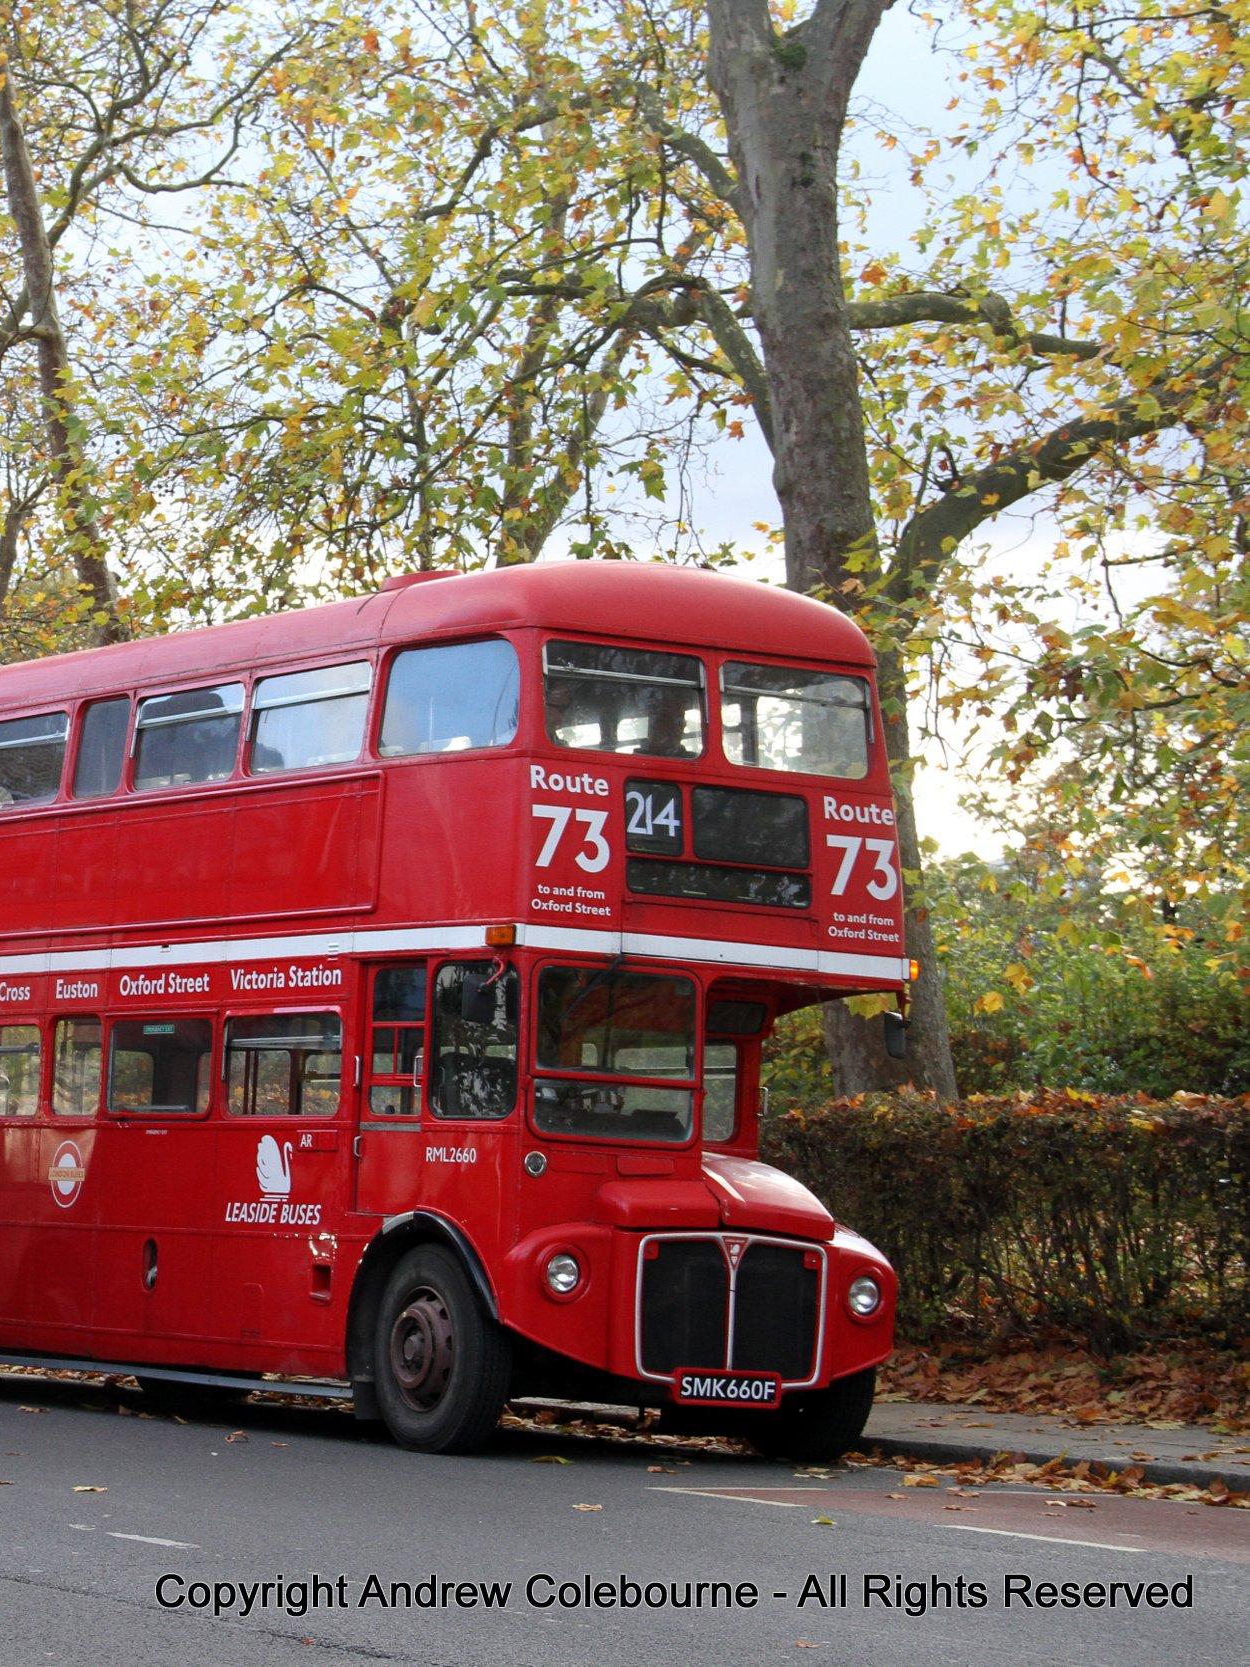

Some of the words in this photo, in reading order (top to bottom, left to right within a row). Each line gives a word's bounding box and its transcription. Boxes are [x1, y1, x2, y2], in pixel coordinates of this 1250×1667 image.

[529, 764, 609, 797] Route
[625, 790, 681, 838] 214
[823, 795, 895, 826] Route
[531, 804, 610, 873] 73
[826, 834, 898, 901] 73
[537, 883, 550, 895] to
[552, 885, 575, 897] and
[576, 886, 605, 899] from
[531, 898, 573, 913] Oxford
[575, 902, 611, 916] Street
[833, 912, 845, 922] to
[847, 913, 867, 924] and
[868, 914, 894, 926] from
[828, 925, 866, 940] Oxford
[867, 929, 900, 942] Street
[55, 978, 98, 999] Euston
[119, 972, 166, 996] Oxford
[168, 972, 210, 994] Street
[230, 967, 286, 990] Victoria
[288, 964, 342, 988] Station
[300, 1134, 313, 1147] AR
[425, 1146, 477, 1163] RML2660
[225, 1202, 279, 1223] LEASIDE
[280, 1204, 322, 1225] BUSES
[680, 1376, 776, 1400] SMK660F
